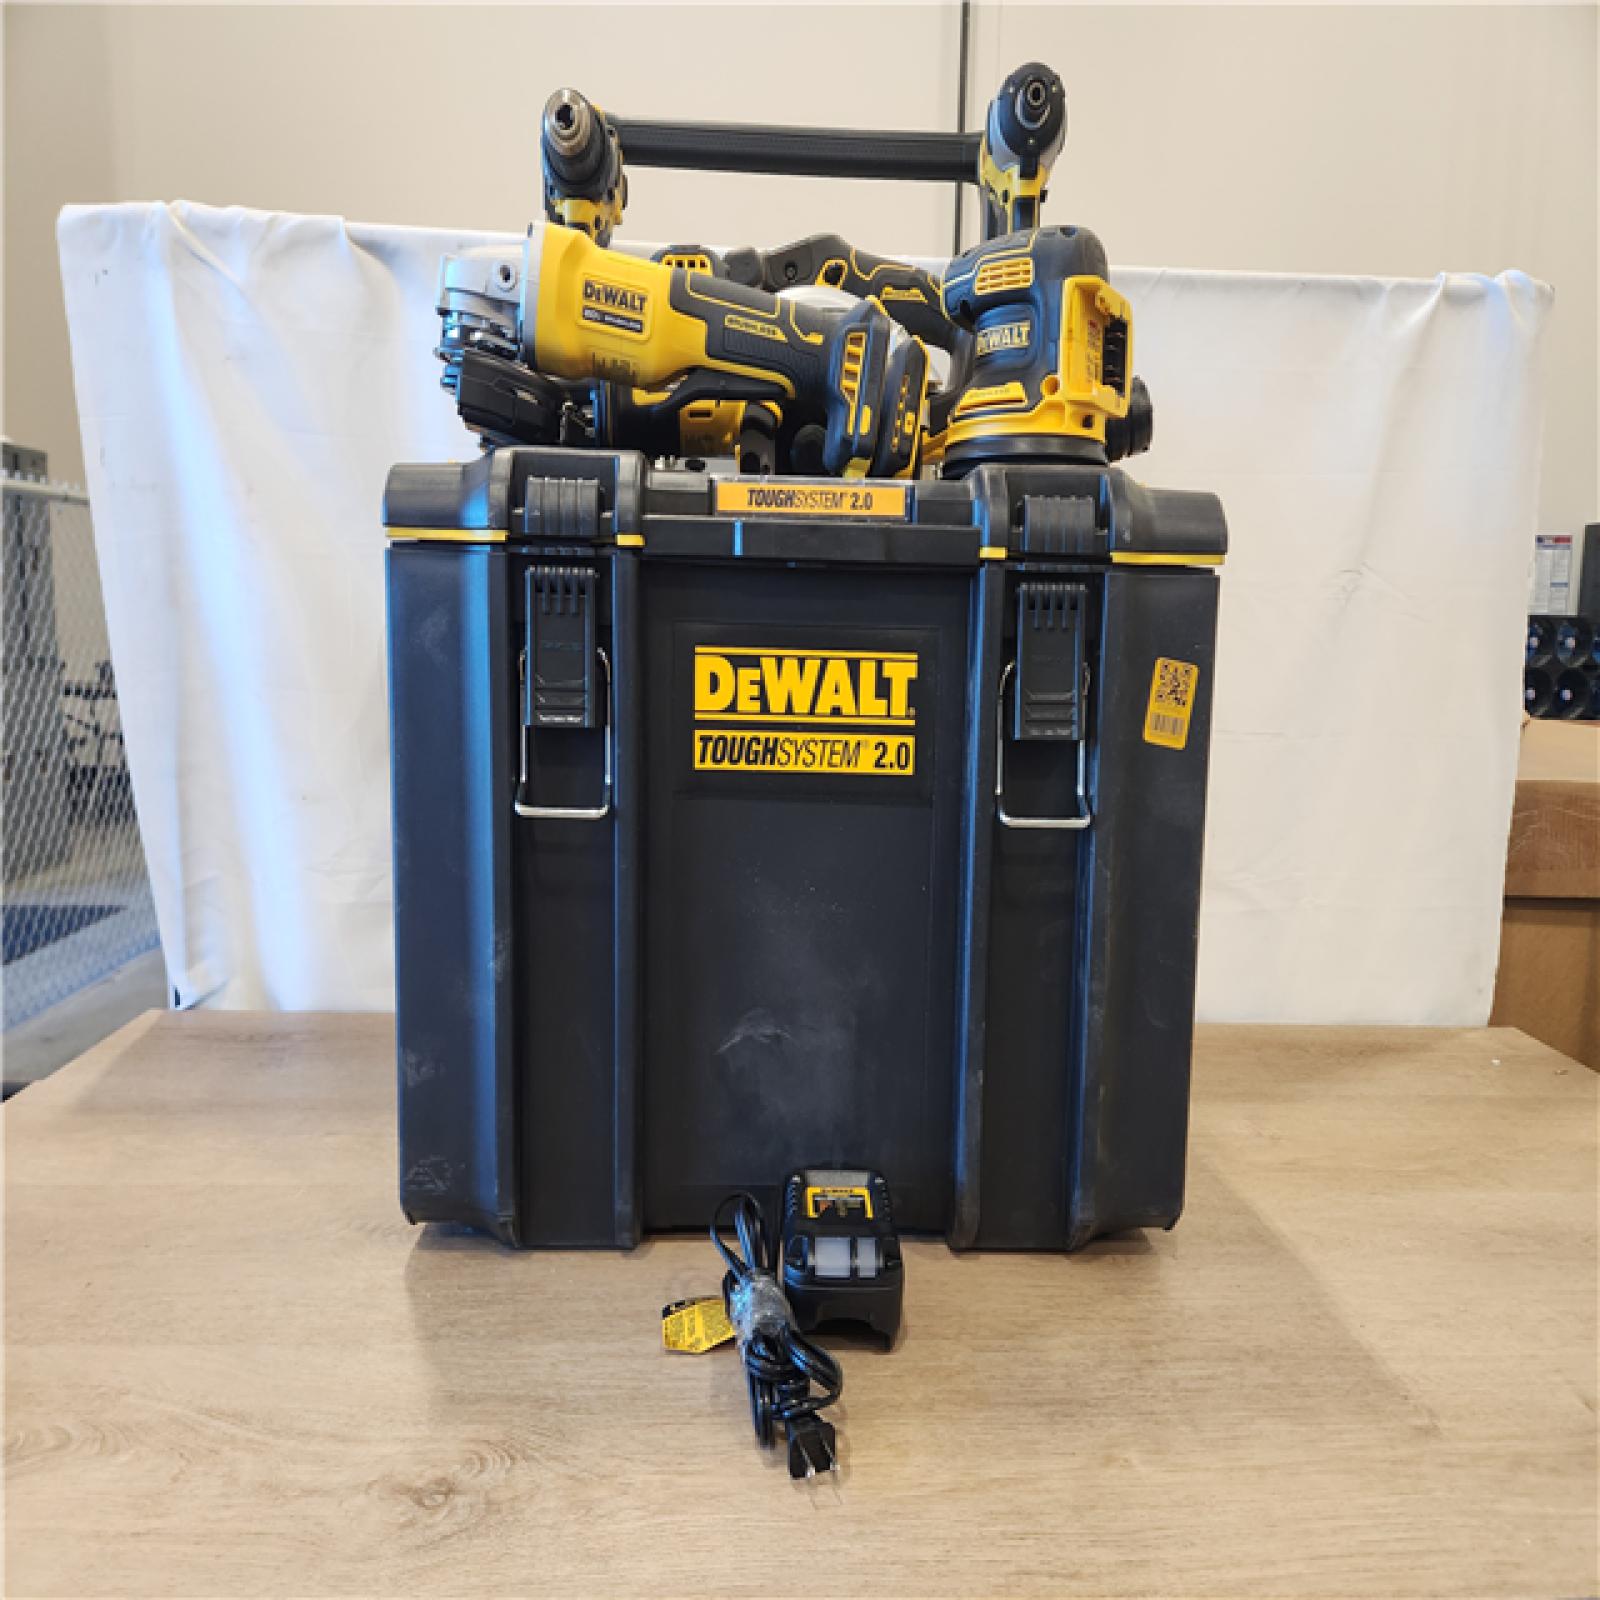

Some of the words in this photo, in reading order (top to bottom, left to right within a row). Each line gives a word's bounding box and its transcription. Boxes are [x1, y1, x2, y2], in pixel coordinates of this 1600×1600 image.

[850, 492, 873, 511] 2.0
[694, 654, 918, 718] DEWALT
[874, 741, 911, 771] 2.0
